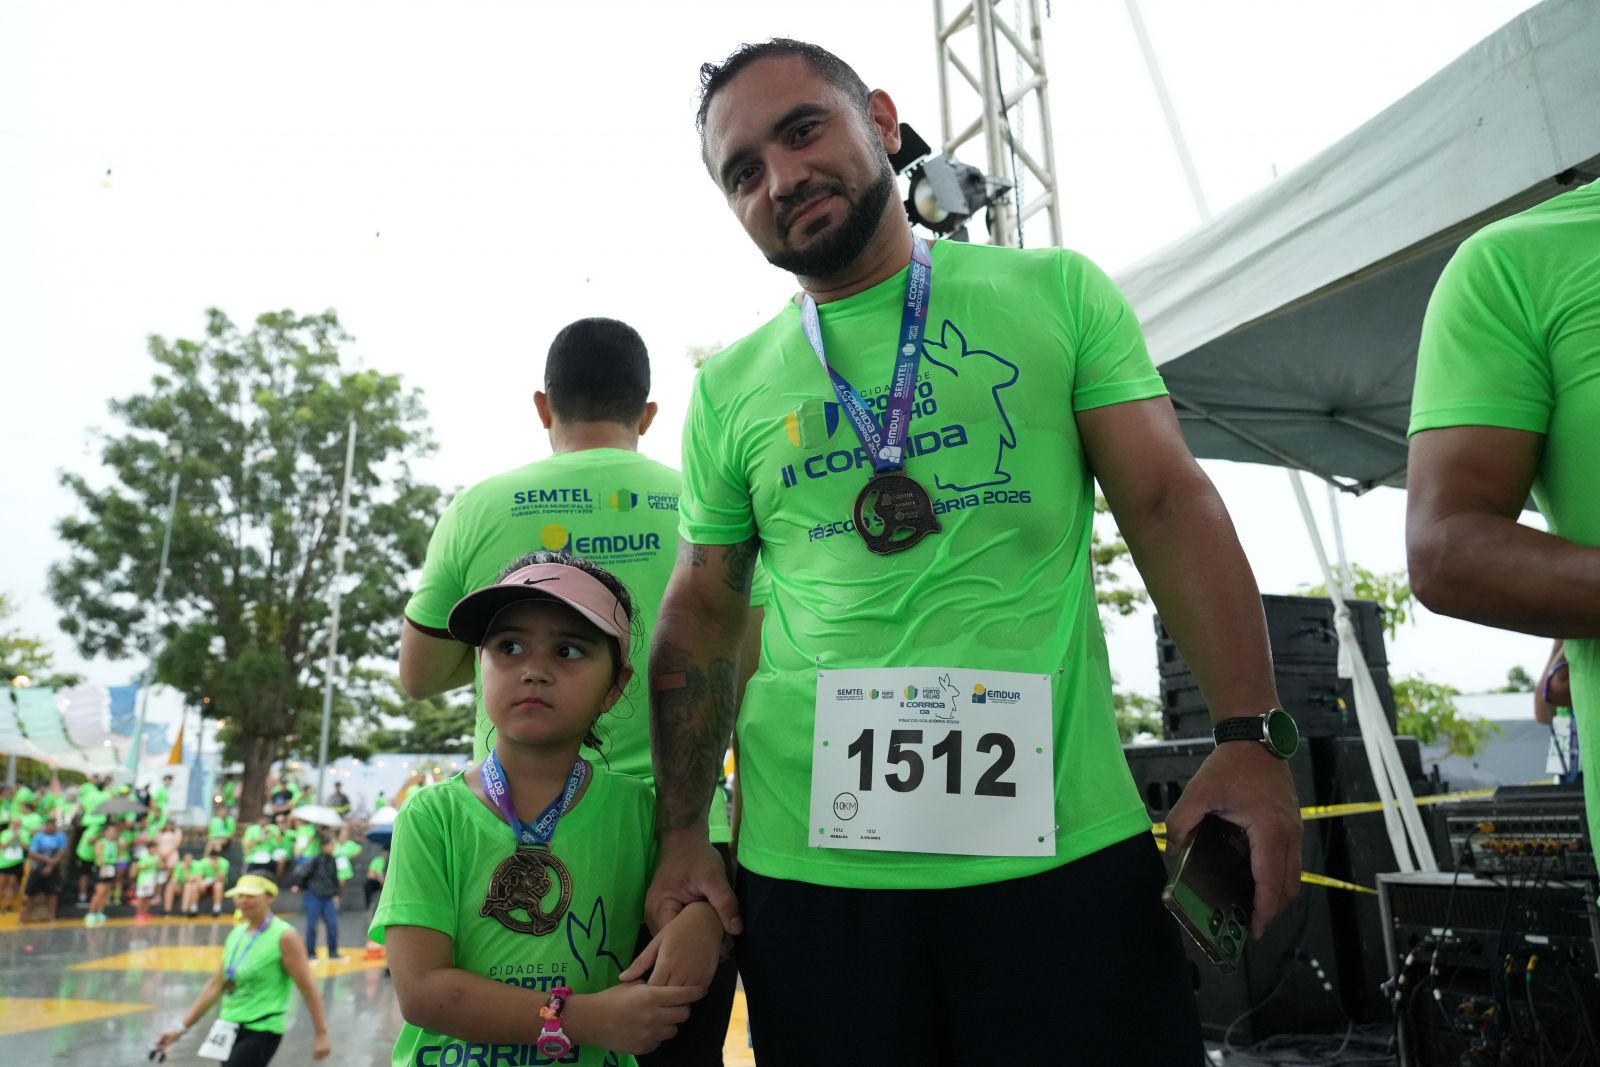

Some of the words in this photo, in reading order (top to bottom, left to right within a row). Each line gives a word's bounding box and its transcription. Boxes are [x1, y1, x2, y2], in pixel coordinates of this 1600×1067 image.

[894, 363, 908, 398] SEMTEL
[888, 408, 901, 445] EMDUR
[781, 464, 798, 488] II
[514, 489, 592, 504] SEMTEL
[648, 495, 679, 503] PORTO
[983, 491, 1031, 504] 2026
[576, 533, 661, 553] EMDUR
[987, 690, 1020, 700] EMDUR
[848, 729, 1016, 797] 1512
[835, 801, 857, 811] 10KM
[489, 964, 544, 976] CIDADE
[552, 962, 568, 973] DE
[495, 975, 566, 992] ORTO
